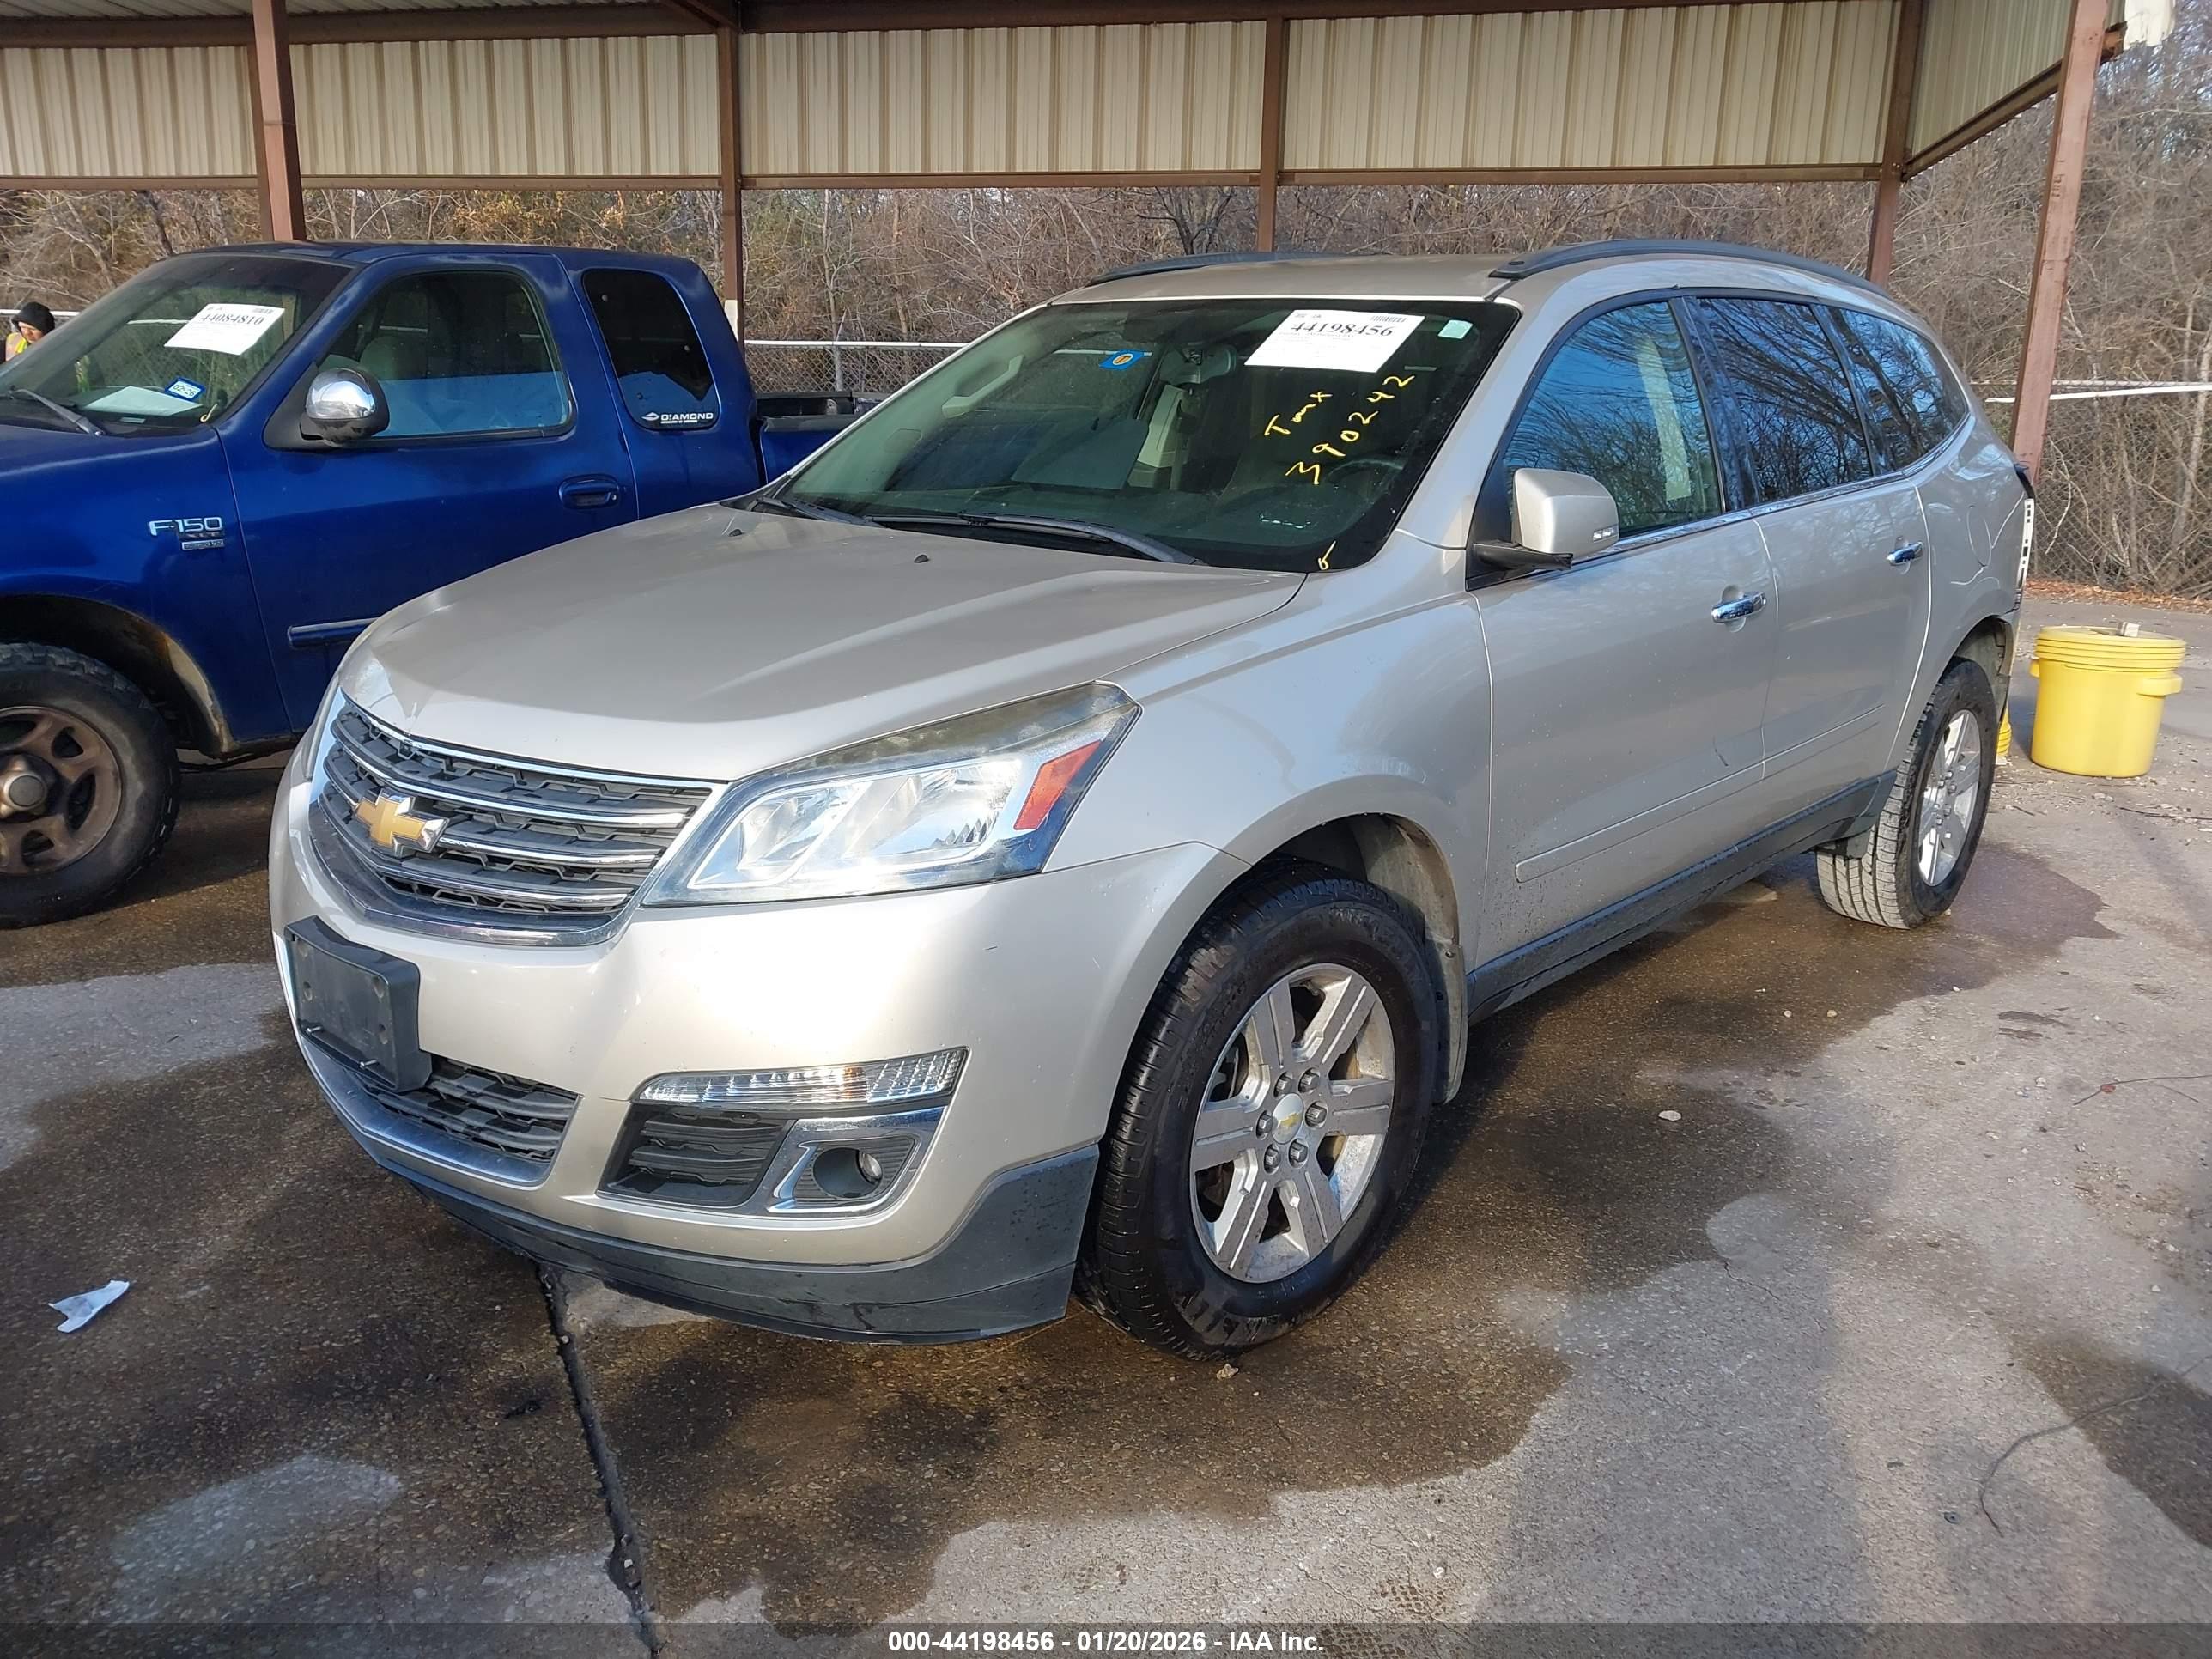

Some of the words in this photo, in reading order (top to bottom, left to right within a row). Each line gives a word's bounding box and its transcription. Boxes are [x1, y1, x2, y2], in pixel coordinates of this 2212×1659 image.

[200, 313, 264, 326] 44084810
[1291, 321, 1396, 337] 44198456
[660, 412, 714, 421] DIAMOND
